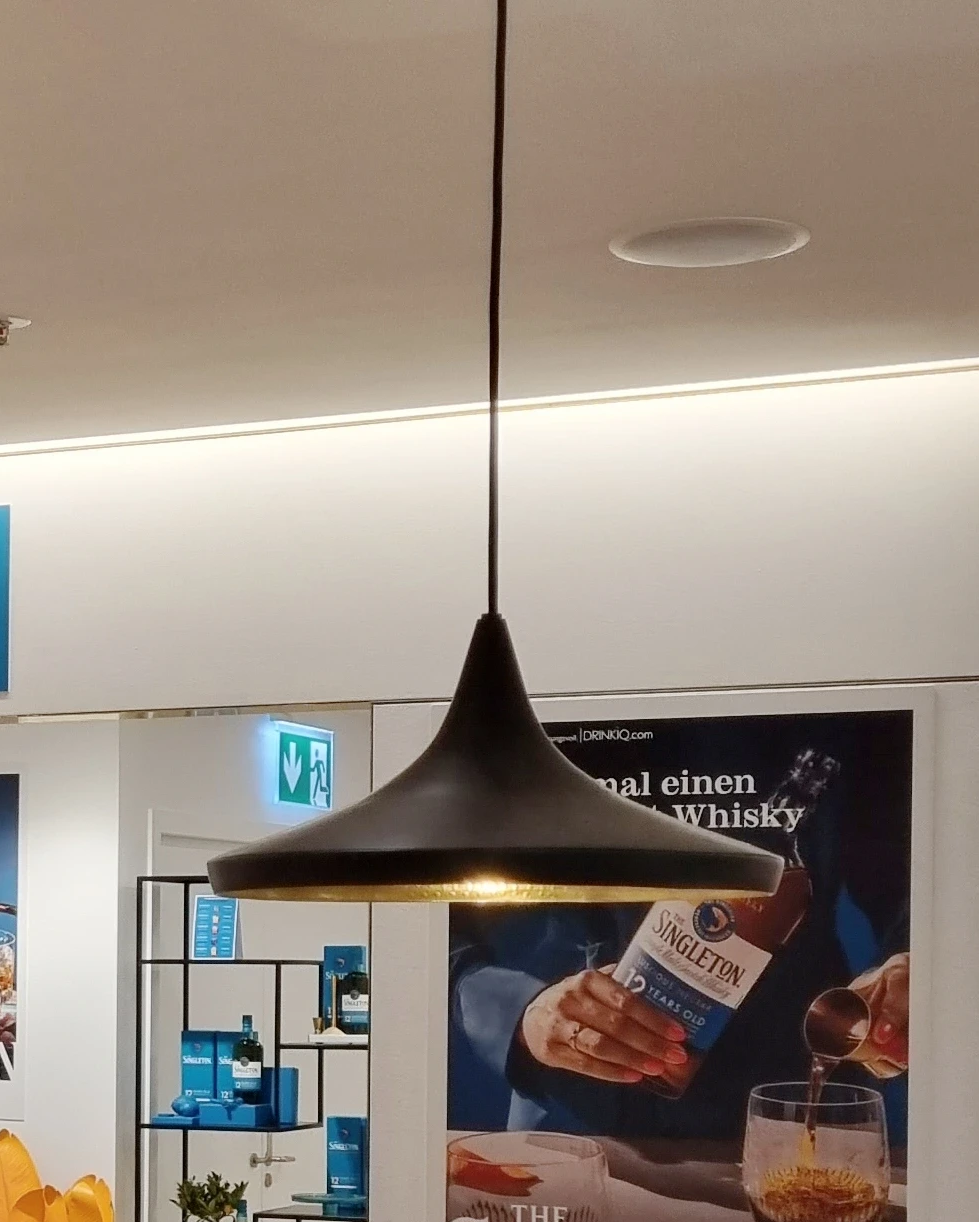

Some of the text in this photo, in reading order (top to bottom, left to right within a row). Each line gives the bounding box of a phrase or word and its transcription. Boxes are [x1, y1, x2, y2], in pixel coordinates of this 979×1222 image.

[661, 769, 757, 796] einen
[672, 801, 806, 833] Whisky
[624, 968, 647, 993] 12
[648, 985, 681, 1014] YEARS
[682, 1009, 706, 1027] OLD
